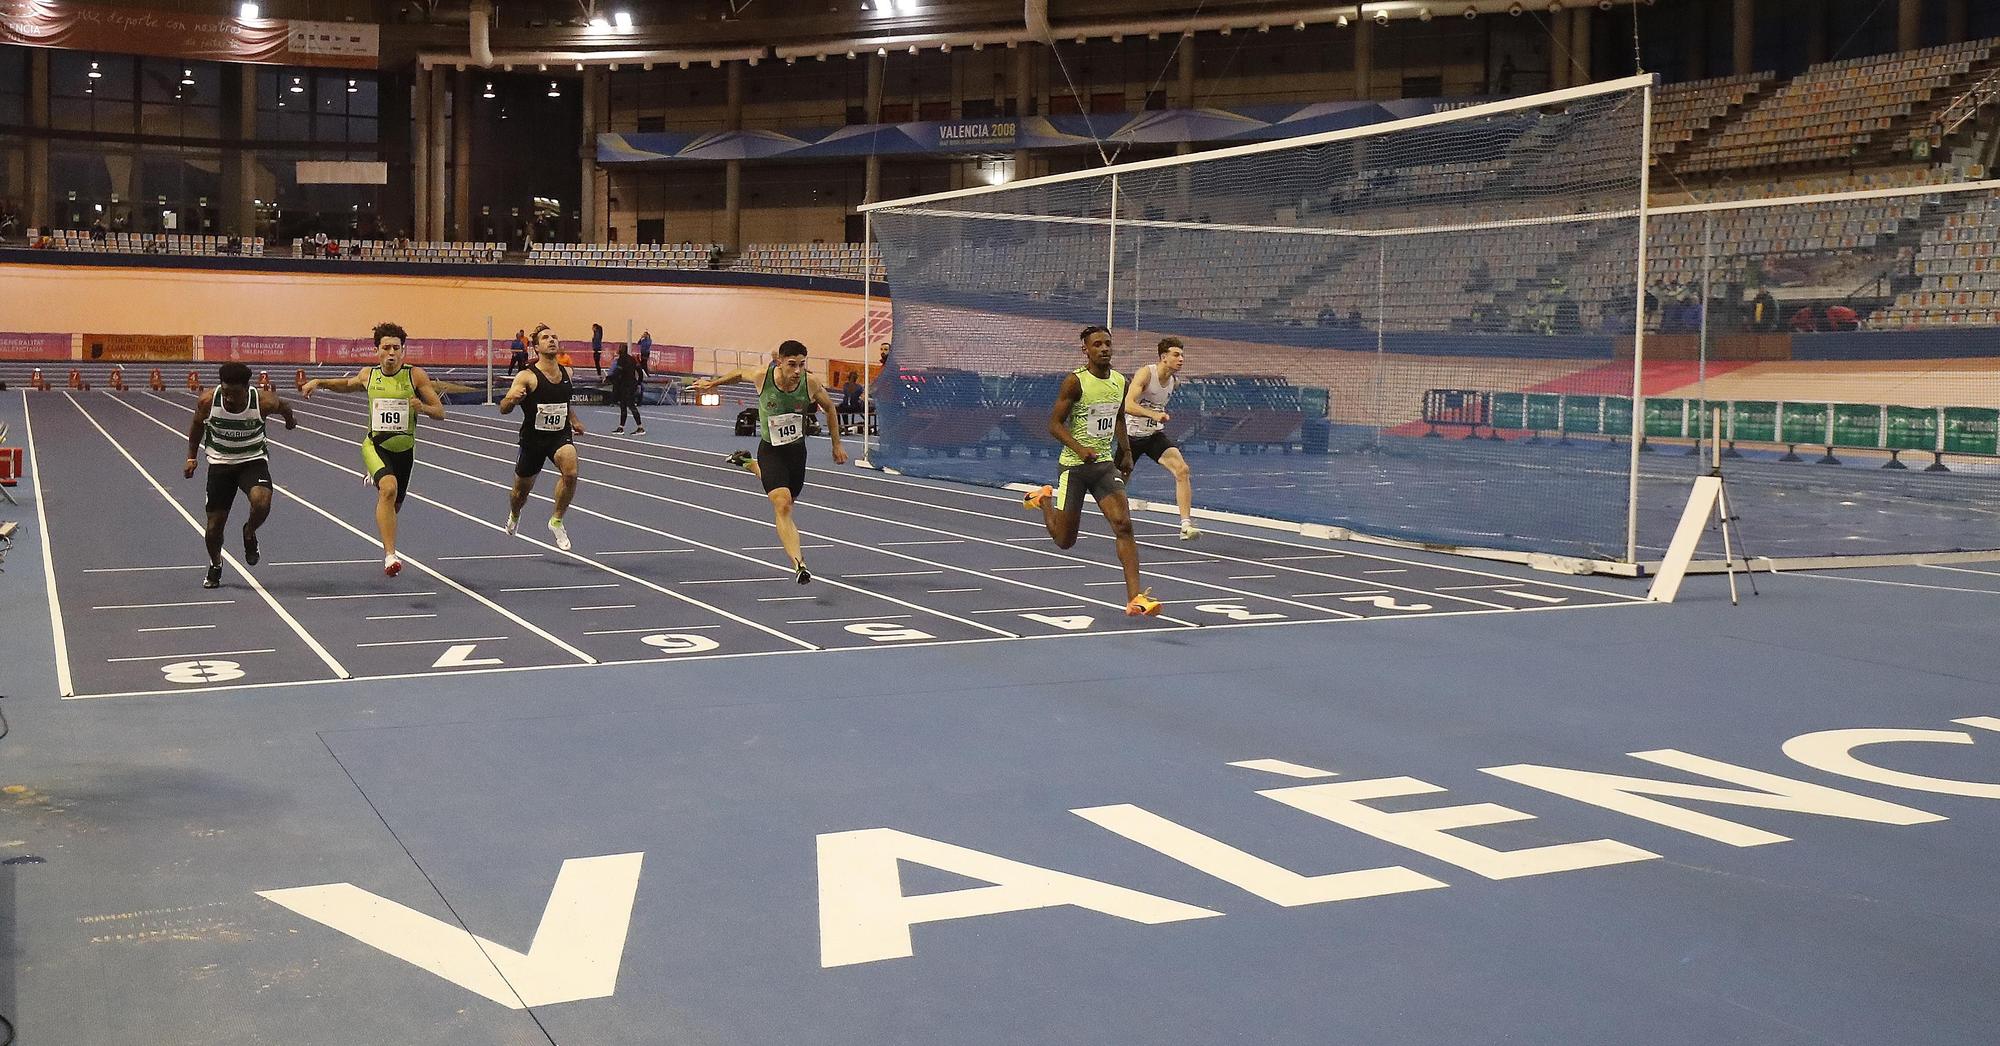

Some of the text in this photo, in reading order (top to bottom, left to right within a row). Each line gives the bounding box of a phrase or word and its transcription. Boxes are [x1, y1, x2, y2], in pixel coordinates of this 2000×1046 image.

[106, 12, 160, 31] deporte
[166, 20, 187, 31] con
[194, 17, 241, 34] nosotros
[940, 123, 1016, 139] VALENCIA 2008
[241, 342, 285, 350] GENERALITAT
[379, 411, 401, 424] 169
[543, 415, 561, 425] 148
[1096, 417, 1113, 431] 104
[777, 424, 797, 438] 149
[1339, 595, 1433, 611] 2
[1492, 589, 1569, 603] 1
[1194, 604, 1288, 621] 3
[1017, 613, 1095, 630] 4
[843, 622, 937, 642] 5
[640, 633, 720, 654] 6
[431, 644, 504, 667] 7
[164, 660, 246, 684] 8
[253, 716, 2000, 1010] VALÈNC
